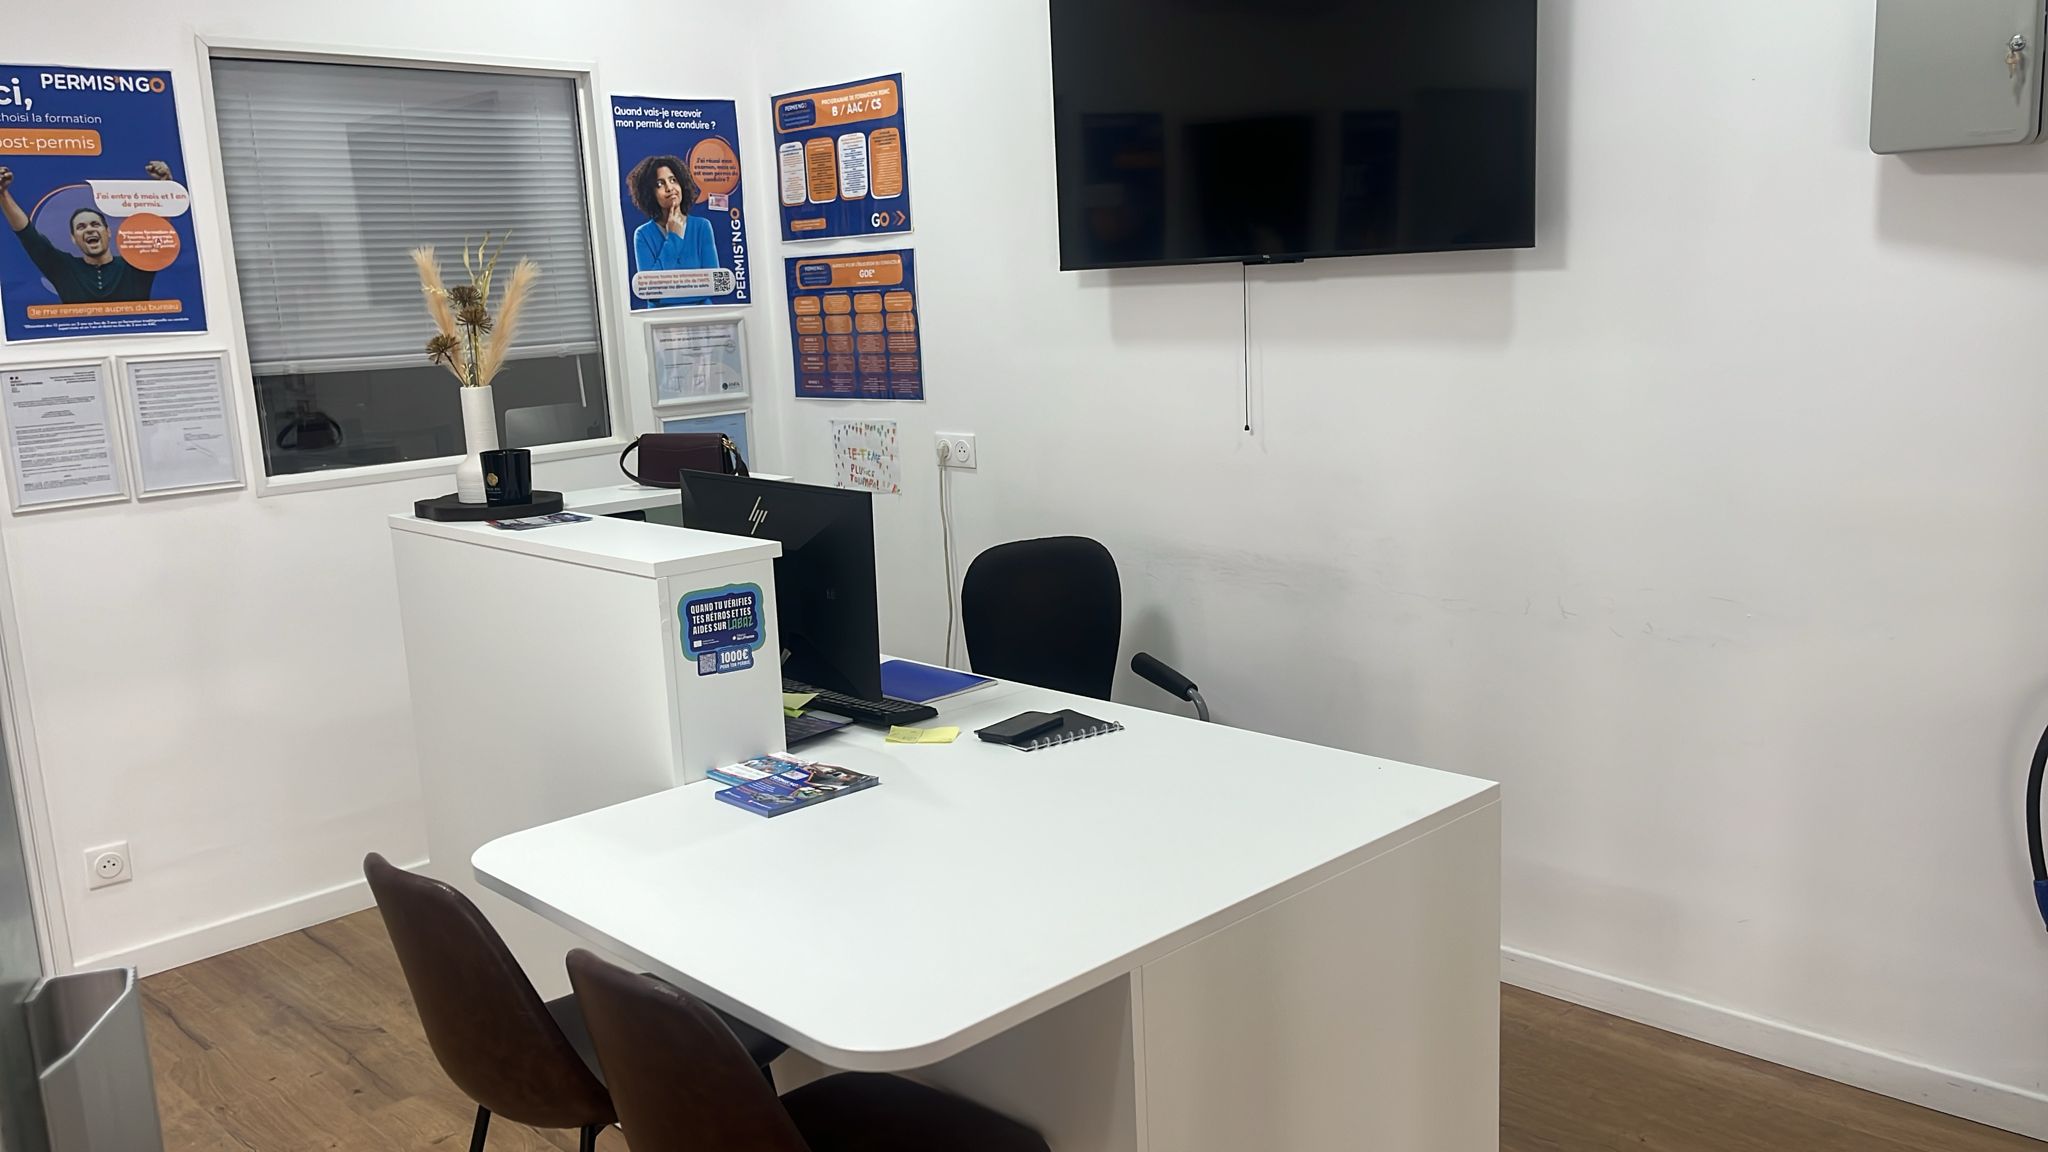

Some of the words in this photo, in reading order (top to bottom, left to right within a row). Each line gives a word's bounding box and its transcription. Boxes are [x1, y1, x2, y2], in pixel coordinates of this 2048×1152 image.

[614, 106, 642, 116] Quand
[643, 107, 669, 119] vais-je
[671, 109, 702, 118] recevoir
[831, 105, 838, 117] B
[846, 101, 863, 115] AAC
[871, 98, 882, 110] CS
[0, 113, 29, 123] hoisi
[32, 113, 42, 123] la
[45, 113, 102, 124] formation
[615, 120, 634, 128] mon
[635, 119, 663, 130] permis
[664, 119, 675, 129] de
[676, 120, 710, 130] conduire
[710, 121, 716, 130] ?
[0, 136, 96, 152] ost-permis
[871, 211, 890, 228] GO
[30, 308, 41, 316] Je
[60, 306, 103, 315] renseigne
[136, 303, 147, 311] du
[148, 303, 179, 311] bureau
[690, 602, 714, 615] QUAND
[714, 601, 723, 610] TU
[723, 596, 752, 609] VÉRIFIES
[692, 614, 705, 625] TES
[705, 610, 731, 622] RÉTROS
[731, 608, 739, 618] ET
[739, 607, 751, 616] TES
[692, 624, 713, 635] AIDES
[713, 621, 727, 631] SUR
[727, 615, 754, 631] LABAZ
[720, 648, 749, 664] 1000€
